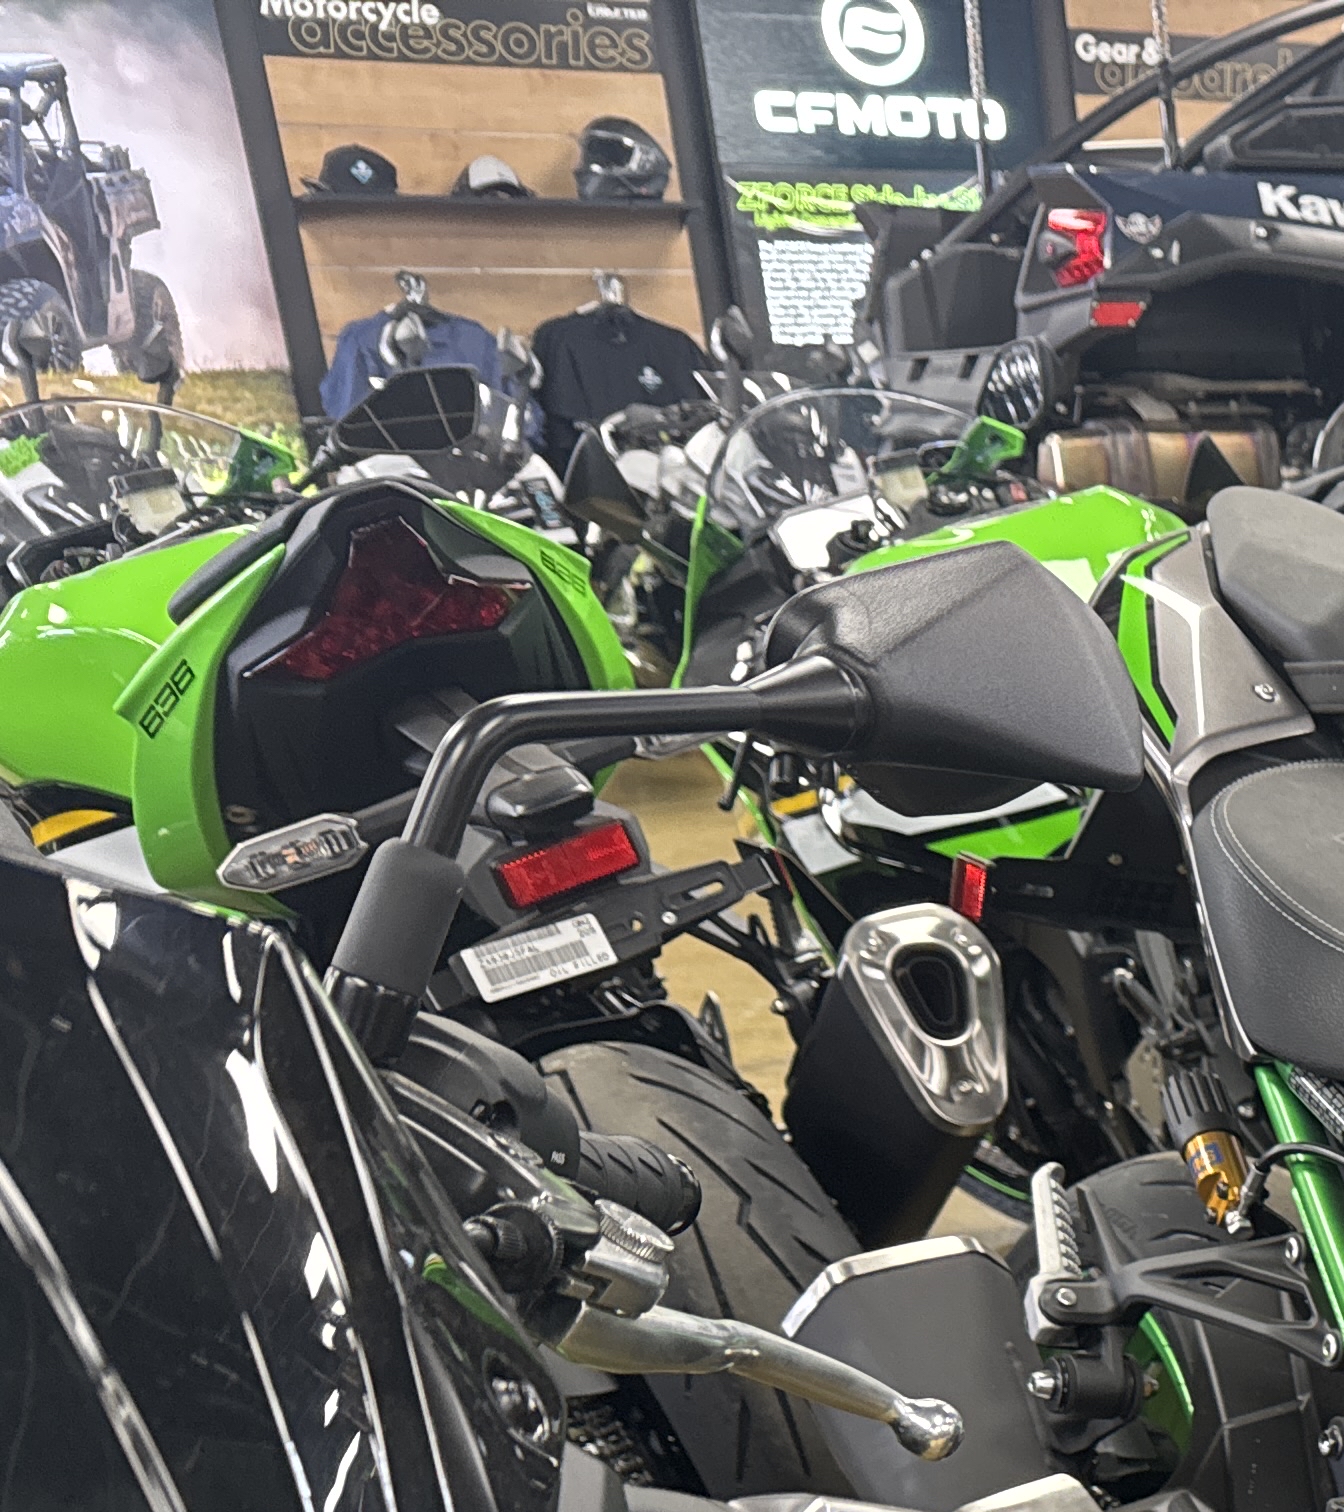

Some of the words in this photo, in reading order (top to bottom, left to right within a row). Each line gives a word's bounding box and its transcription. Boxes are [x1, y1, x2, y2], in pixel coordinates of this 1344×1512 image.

[258, 0, 441, 30] Motorcycle
[288, 8, 653, 70] accessories
[1075, 33, 1142, 64] Gear
[1141, 37, 1163, 66] &
[754, 89, 1008, 141] CFMOTO
[139, 658, 196, 739] 636
